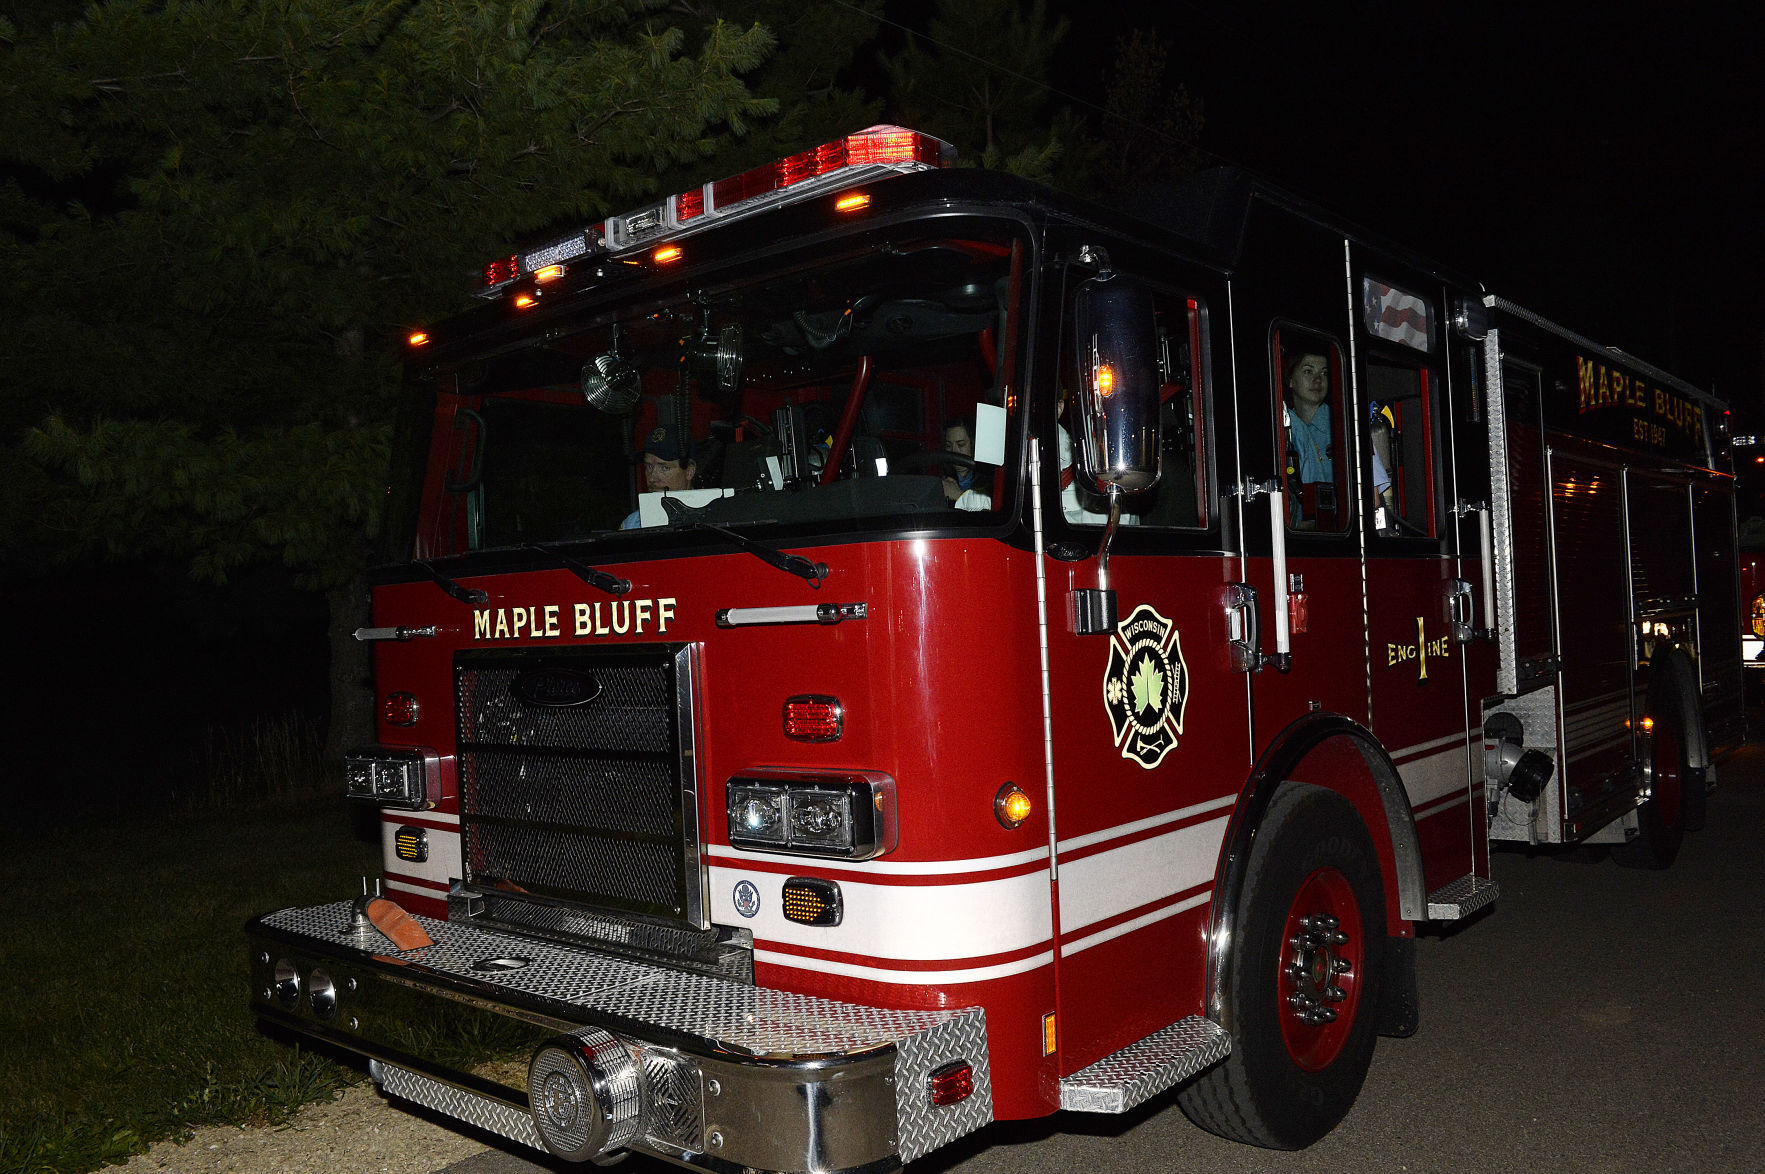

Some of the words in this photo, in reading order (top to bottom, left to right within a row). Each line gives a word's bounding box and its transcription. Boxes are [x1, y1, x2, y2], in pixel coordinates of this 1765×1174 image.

[1576, 355, 1648, 413] MAPLE
[1653, 387, 1702, 449] BLUFF
[473, 605, 561, 640] MAPLE
[573, 597, 677, 638] BLUFF
[1124, 619, 1166, 640] WISCONSIN
